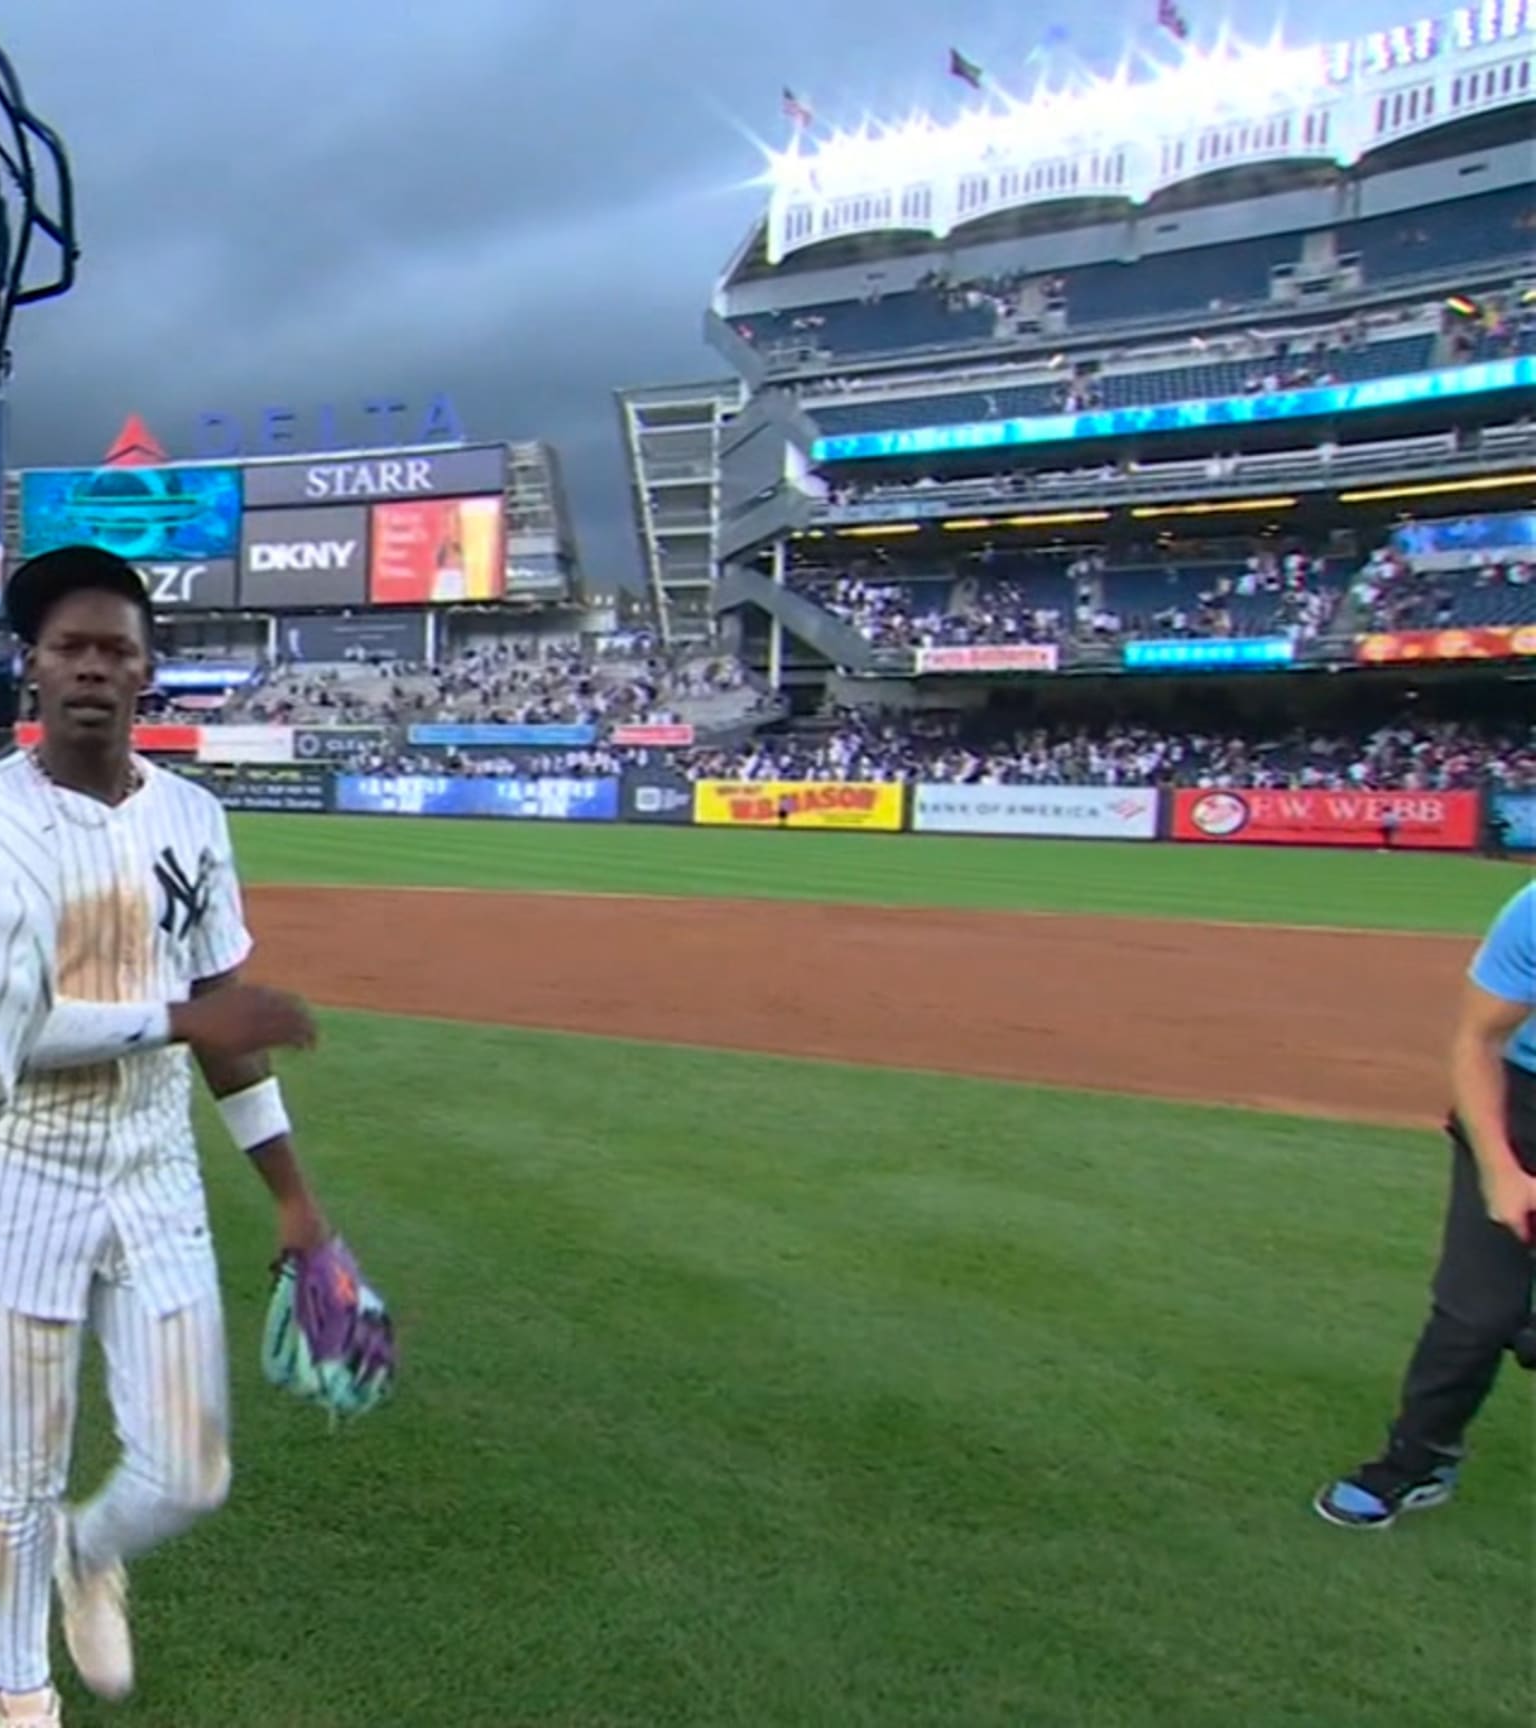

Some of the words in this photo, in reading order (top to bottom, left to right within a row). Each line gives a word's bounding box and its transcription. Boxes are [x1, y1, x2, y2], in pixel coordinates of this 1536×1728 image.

[195, 393, 464, 456] DELTA
[305, 459, 435, 498] STARR
[249, 540, 357, 572] DKNY
[1006, 804, 1101, 819] AMERICA
